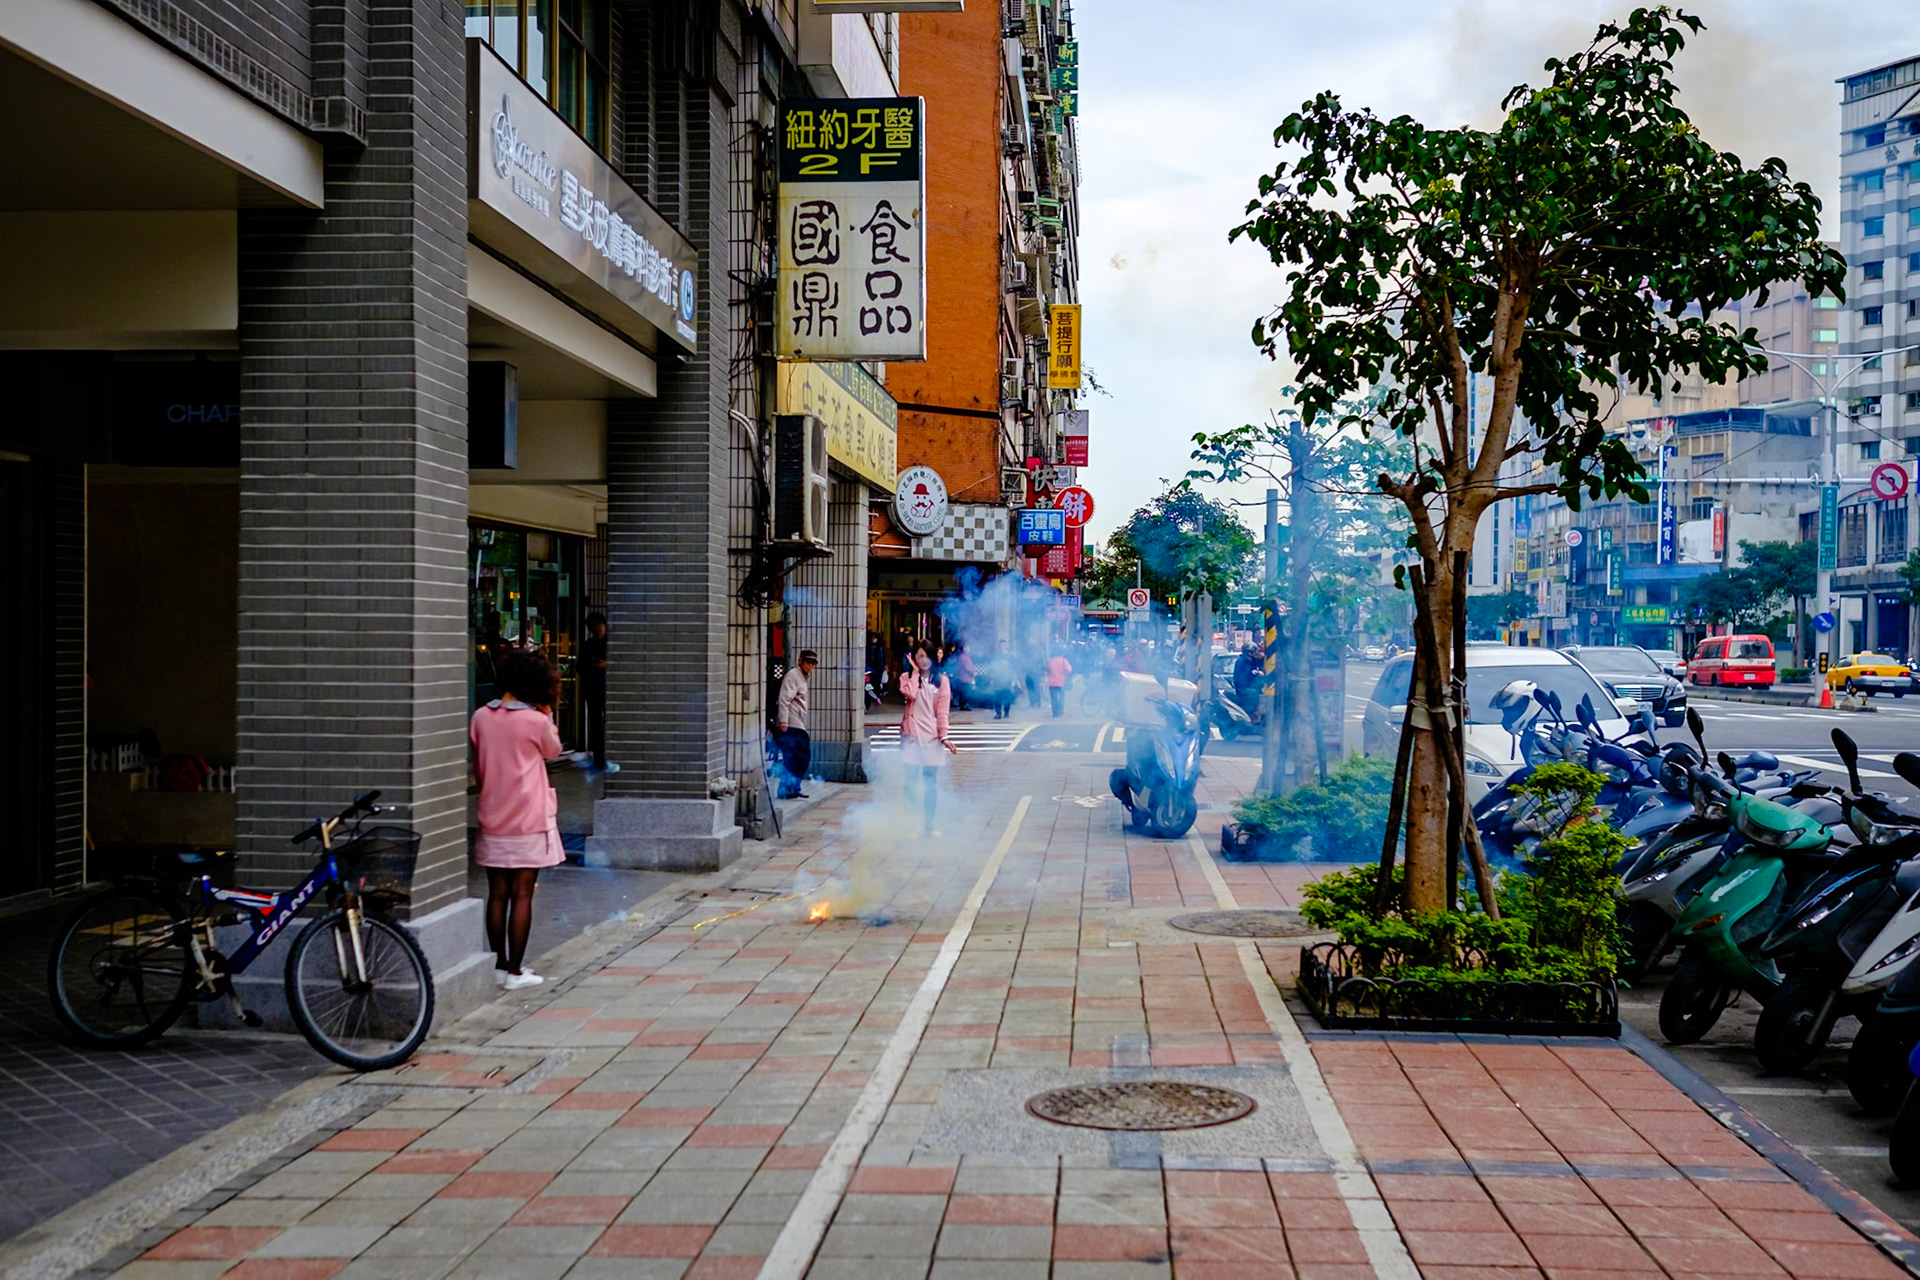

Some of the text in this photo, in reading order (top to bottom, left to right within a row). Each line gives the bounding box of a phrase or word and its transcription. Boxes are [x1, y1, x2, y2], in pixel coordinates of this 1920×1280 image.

[785, 107, 914, 150] 紐約牙醫
[859, 199, 912, 336] 食品
[1056, 311, 1073, 369] 菩提行願
[1021, 513, 1061, 530] 百靈鳥
[1059, 491, 1088, 523] 餅
[1028, 530, 1054, 542] 皮鞋
[256, 879, 315, 946] GIANT
